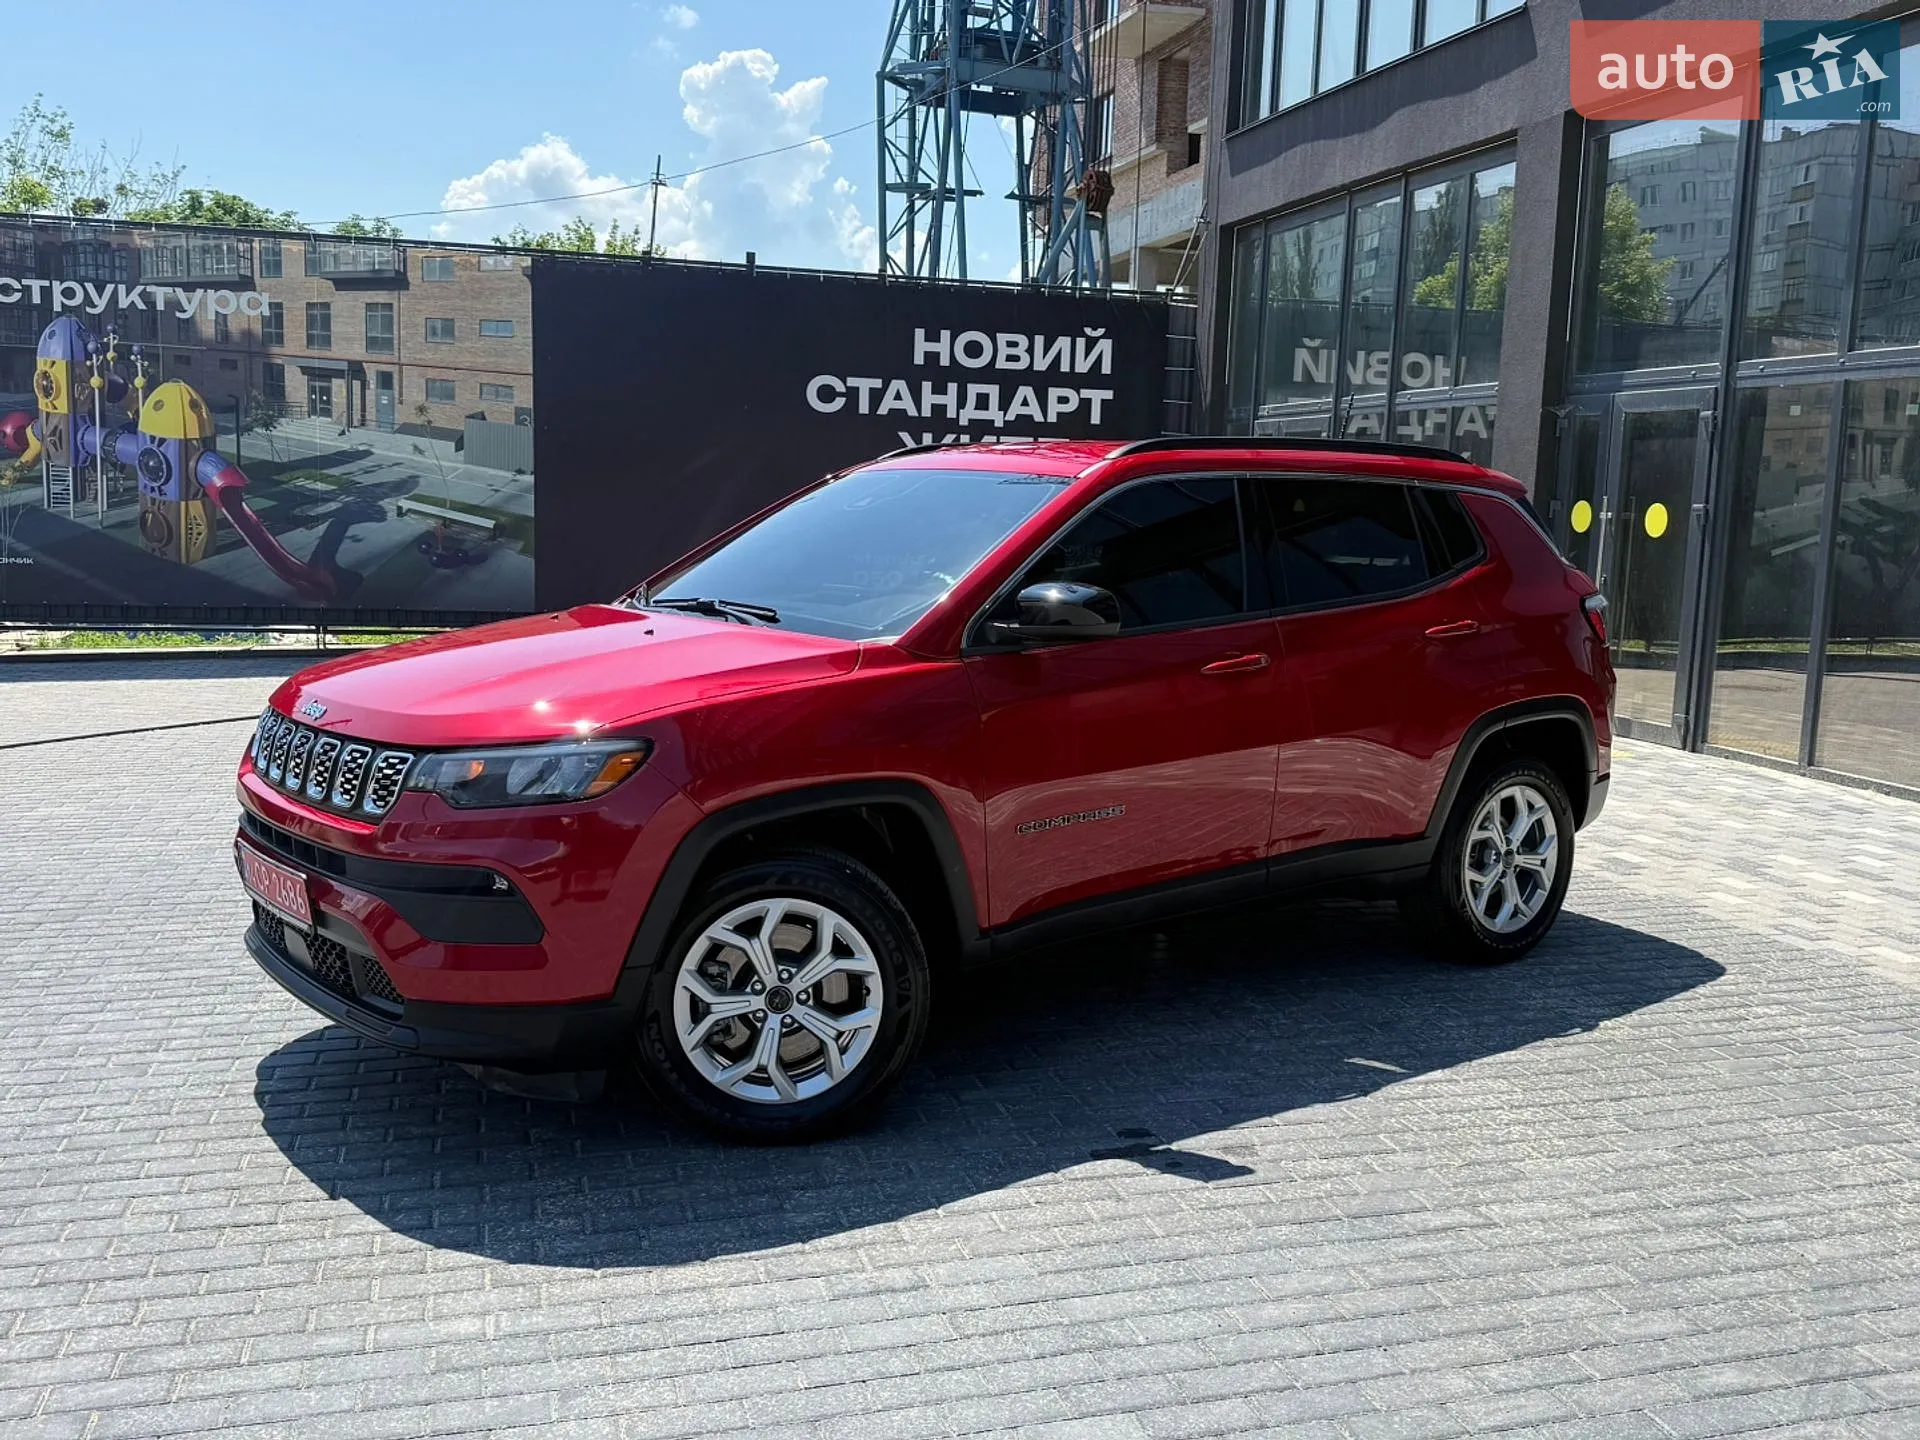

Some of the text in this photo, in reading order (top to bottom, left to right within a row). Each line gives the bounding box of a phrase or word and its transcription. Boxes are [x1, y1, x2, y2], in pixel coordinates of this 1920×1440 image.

[0, 277, 271, 320] структура
[913, 326, 1114, 375] НОВИЙ
[805, 374, 1115, 428] СТАНДАРТ
[1016, 804, 1127, 835] COMPASS
